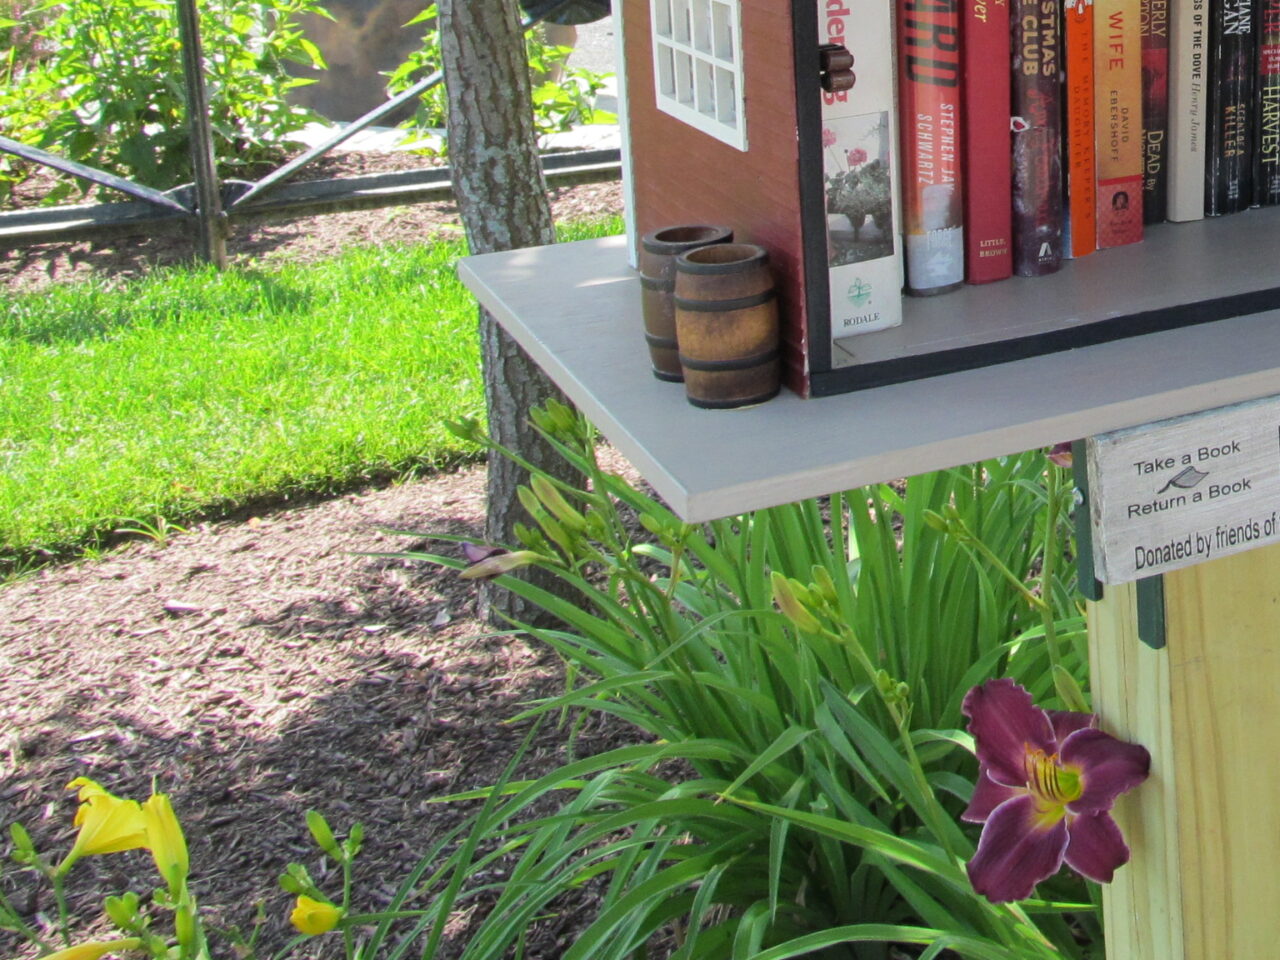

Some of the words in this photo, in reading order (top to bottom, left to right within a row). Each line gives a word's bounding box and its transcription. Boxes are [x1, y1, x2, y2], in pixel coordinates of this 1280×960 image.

[1022, 15, 1038, 76] CLUB
[1109, 12, 1123, 71] WIFE
[1193, 14, 1202, 27] OF
[1193, 30, 1202, 49] THE
[1192, 52, 1202, 80] DOVE
[1082, 76, 1090, 136] MEMORY
[1190, 82, 1201, 115] Henry
[917, 113, 934, 185] SCHWARTZ
[940, 103, 954, 161] STEPHEN
[1073, 86, 1081, 169] DAUGHTER
[1110, 90, 1118, 163] EBERSHOFF
[1190, 118, 1200, 152] James
[1224, 105, 1236, 158] KILLER
[1262, 86, 1280, 165] HARVEST
[1147, 130, 1163, 175] DEAD
[843, 312, 881, 329] RODALE
[1134, 455, 1175, 476] Take
[1181, 454, 1192, 465] a
[1198, 440, 1241, 461] Book
[1128, 495, 1187, 519] Return
[1192, 491, 1202, 502] a
[1208, 478, 1252, 499] Book
[1134, 535, 1193, 570] Donated
[1196, 530, 1213, 558] by
[1215, 518, 1260, 549] friends
[1263, 511, 1277, 536] of
